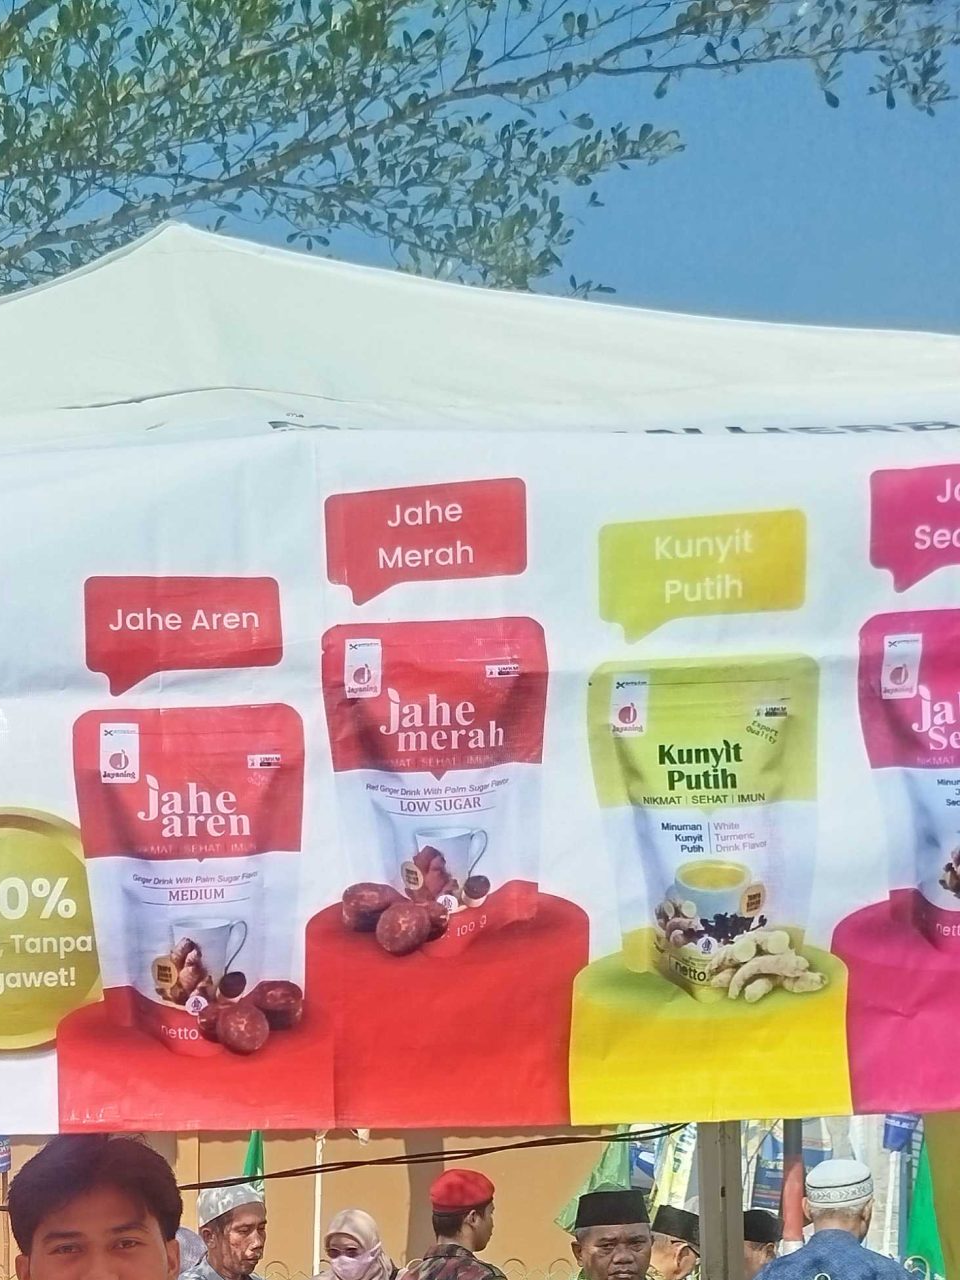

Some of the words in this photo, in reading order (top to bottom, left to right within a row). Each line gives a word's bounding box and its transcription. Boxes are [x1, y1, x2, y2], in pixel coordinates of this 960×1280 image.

[387, 500, 463, 528] Jahe
[654, 528, 754, 563] Kunyit
[378, 541, 474, 569] Merah
[664, 575, 743, 603] Putih
[109, 608, 183, 632] Jahe
[191, 608, 260, 631] Aren
[398, 721, 504, 752] merah
[746, 725, 777, 745] Quality
[752, 720, 779, 737] Export
[658, 740, 743, 768] Kunyit
[668, 768, 737, 790] Putih
[400, 788, 421, 796] Drink
[423, 787, 442, 795] With
[445, 785, 467, 794] Palm
[469, 783, 490, 794] Sugar
[400, 800, 431, 812] LOW
[434, 797, 482, 812] SUGAR
[643, 796, 682, 805] NIKMAT
[691, 795, 728, 804] SEHAT
[737, 793, 766, 803] IMUN
[161, 813, 251, 838] aren
[661, 822, 703, 831] Minuman
[713, 822, 740, 831] White
[675, 834, 703, 843] Kunyit
[715, 844, 740, 853] Drink
[742, 840, 768, 850] Flavor
[680, 844, 704, 854] Putih
[153, 876, 173, 885] Drink
[176, 876, 193, 884] With
[195, 875, 215, 884] Palm
[217, 873, 240, 884] Sugar
[168, 888, 225, 902] MEDIUM
[14, 931, 93, 957] Tanpa
